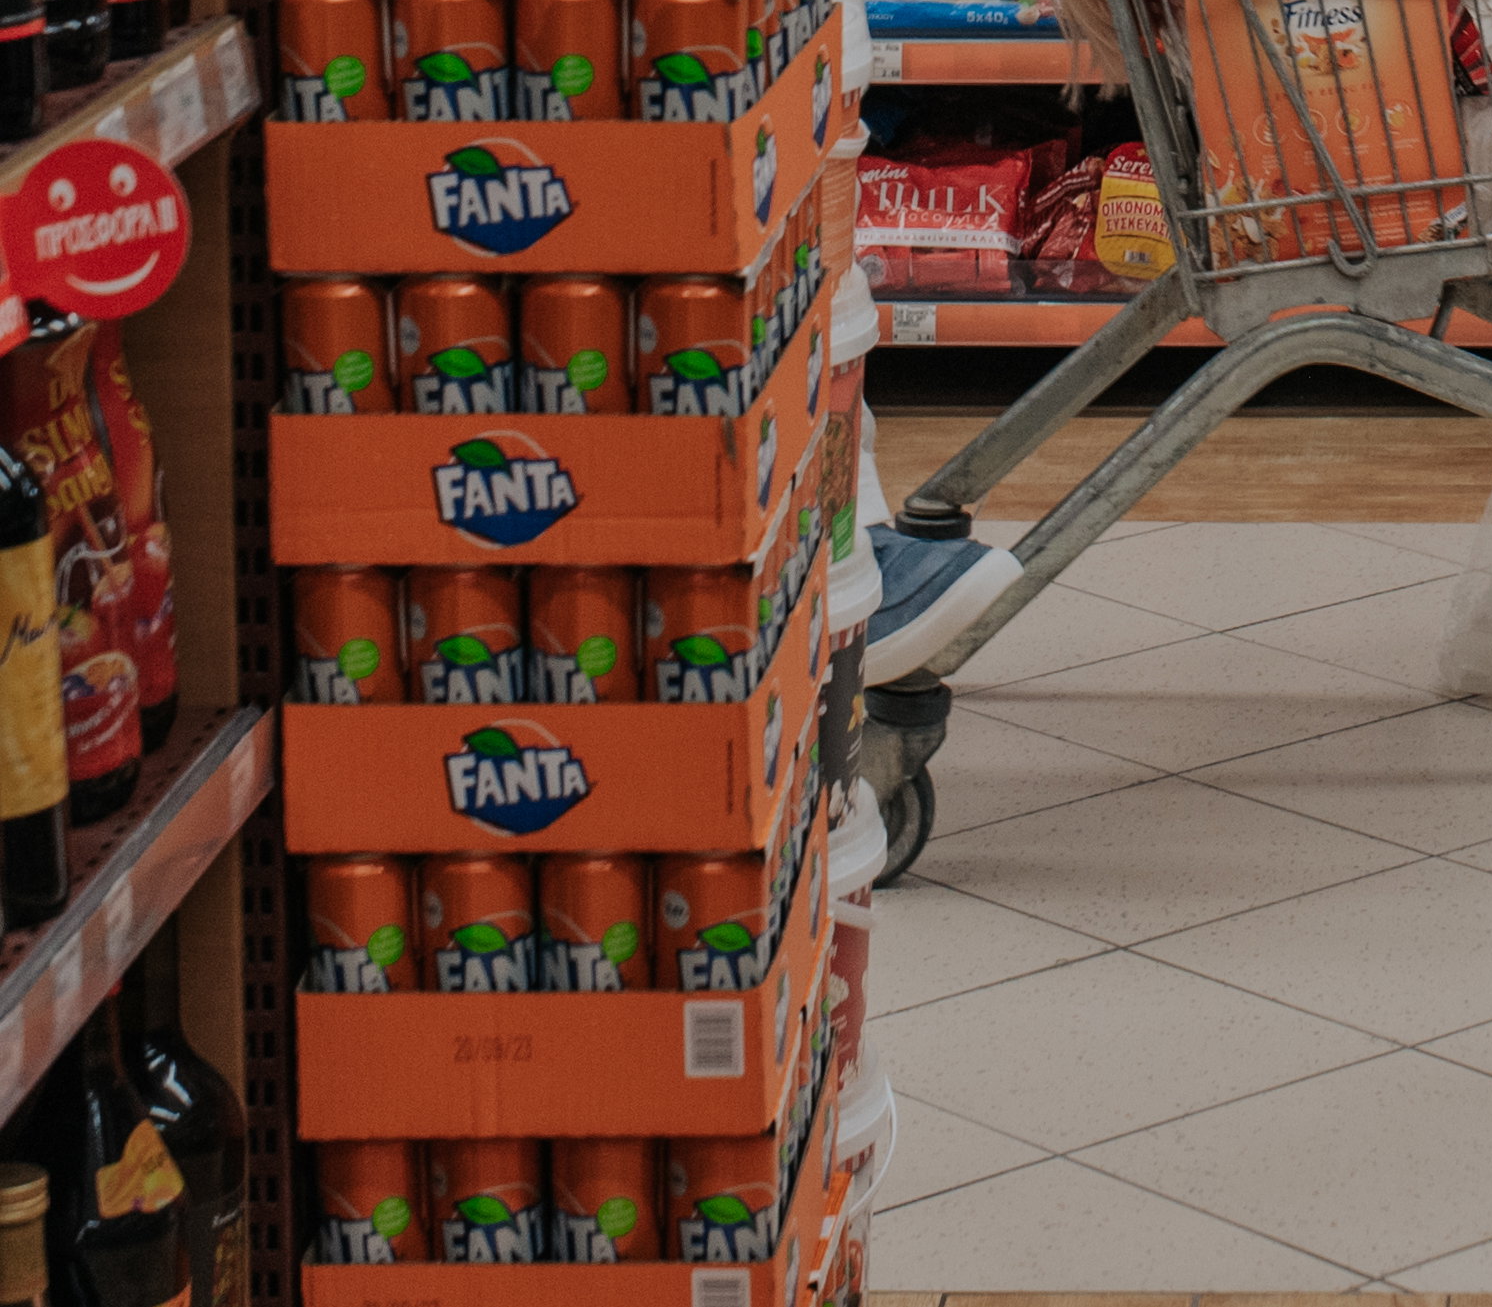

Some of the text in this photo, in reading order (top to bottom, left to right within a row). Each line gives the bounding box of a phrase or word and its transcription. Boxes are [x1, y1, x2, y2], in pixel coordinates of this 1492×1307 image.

[429, 166, 571, 230] FANTA
[1101, 200, 1165, 218] ΟΙΚΟΝΟΜ
[435, 458, 576, 522] FANTA
[446, 747, 589, 812] FANTA
